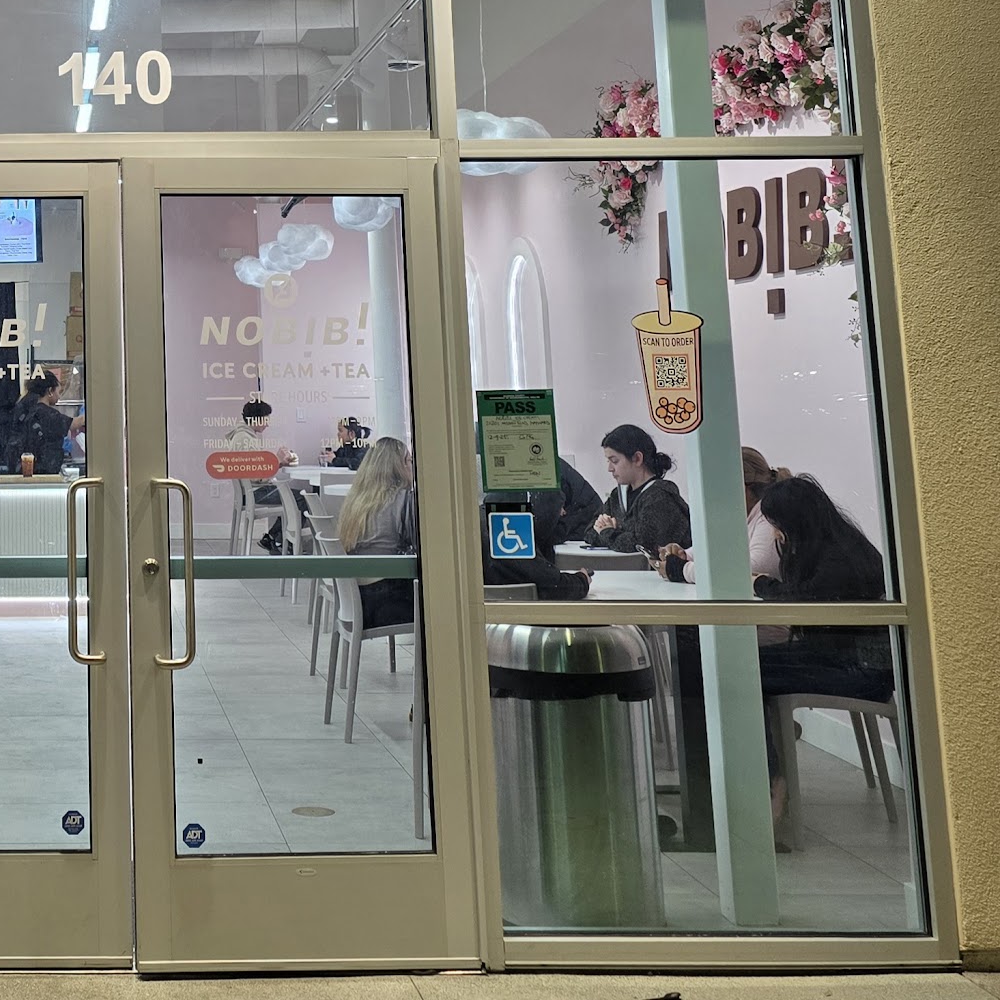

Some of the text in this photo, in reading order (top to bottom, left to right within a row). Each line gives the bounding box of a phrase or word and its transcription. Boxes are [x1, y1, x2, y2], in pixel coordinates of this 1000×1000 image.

[58, 50, 172, 107] 140
[643, 338, 694, 347] SCAN TO ORDER
[202, 363, 235, 379] ICE
[242, 362, 313, 379] CREAM
[288, 391, 328, 403] HOURS
[494, 401, 536, 414] PASS
[202, 416, 238, 427] SUNDAY
[203, 438, 235, 449] FRIDAY
[227, 464, 274, 472] DOORDASH
[65, 816, 82, 825] ADT
[185, 830, 202, 839] ADT
